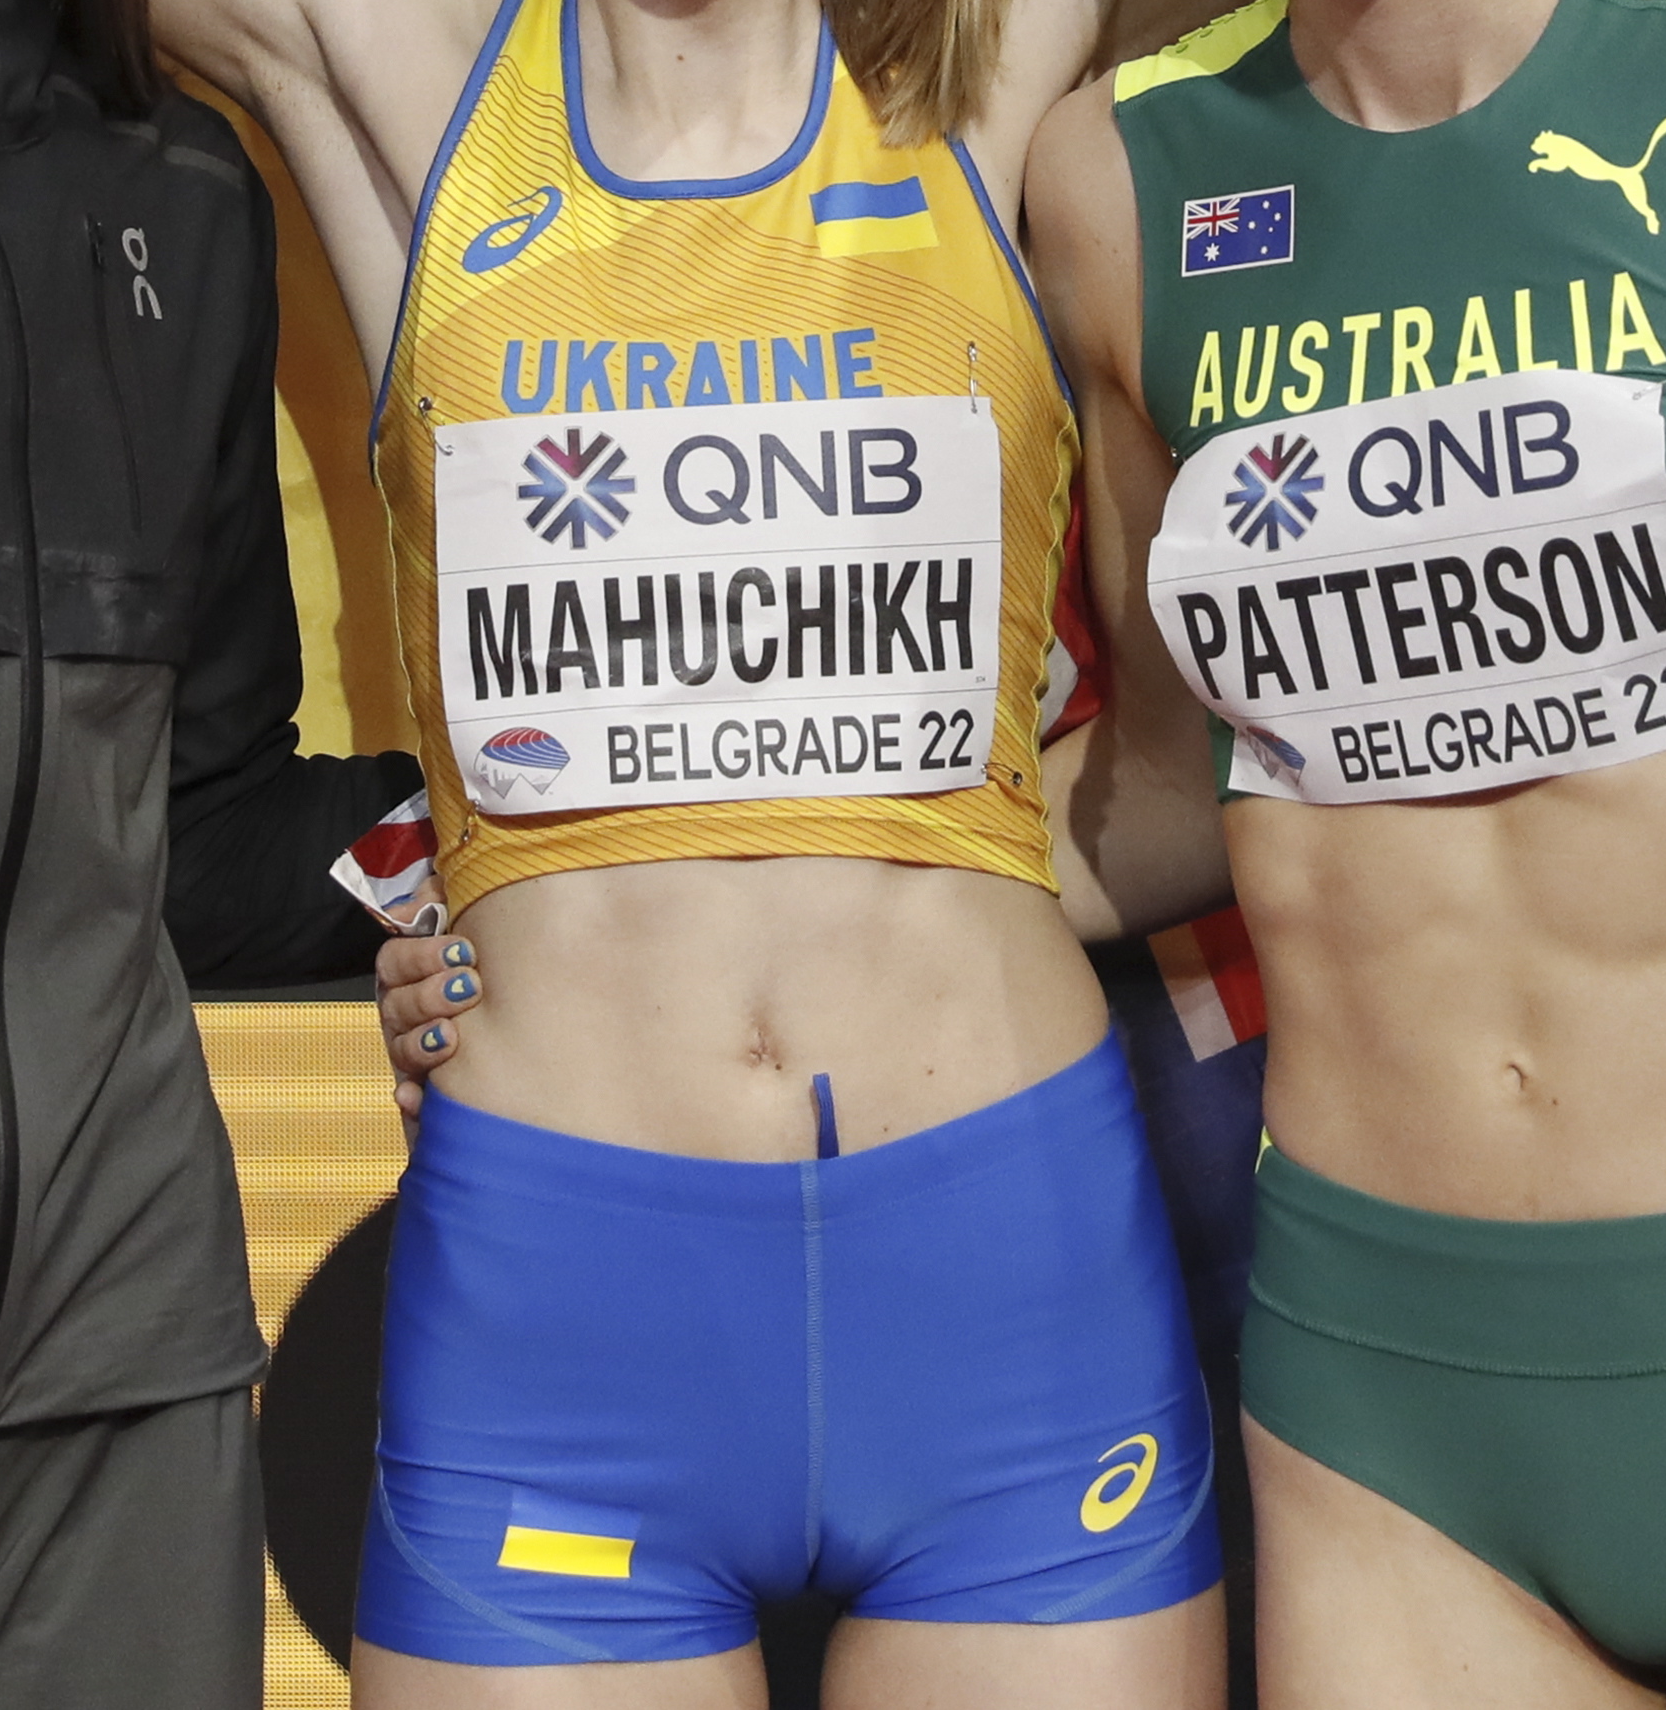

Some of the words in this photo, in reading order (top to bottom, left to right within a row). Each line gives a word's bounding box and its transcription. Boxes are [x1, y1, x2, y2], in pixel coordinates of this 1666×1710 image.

[501, 328, 884, 414] UKRAINE
[663, 428, 923, 526] QNB
[1348, 400, 1580, 518] QNB
[466, 558, 974, 701] MAHUCHIKH
[607, 713, 903, 785] BELGRADE
[918, 708, 975, 771] 22
[1332, 688, 1617, 784] BELGRADE
